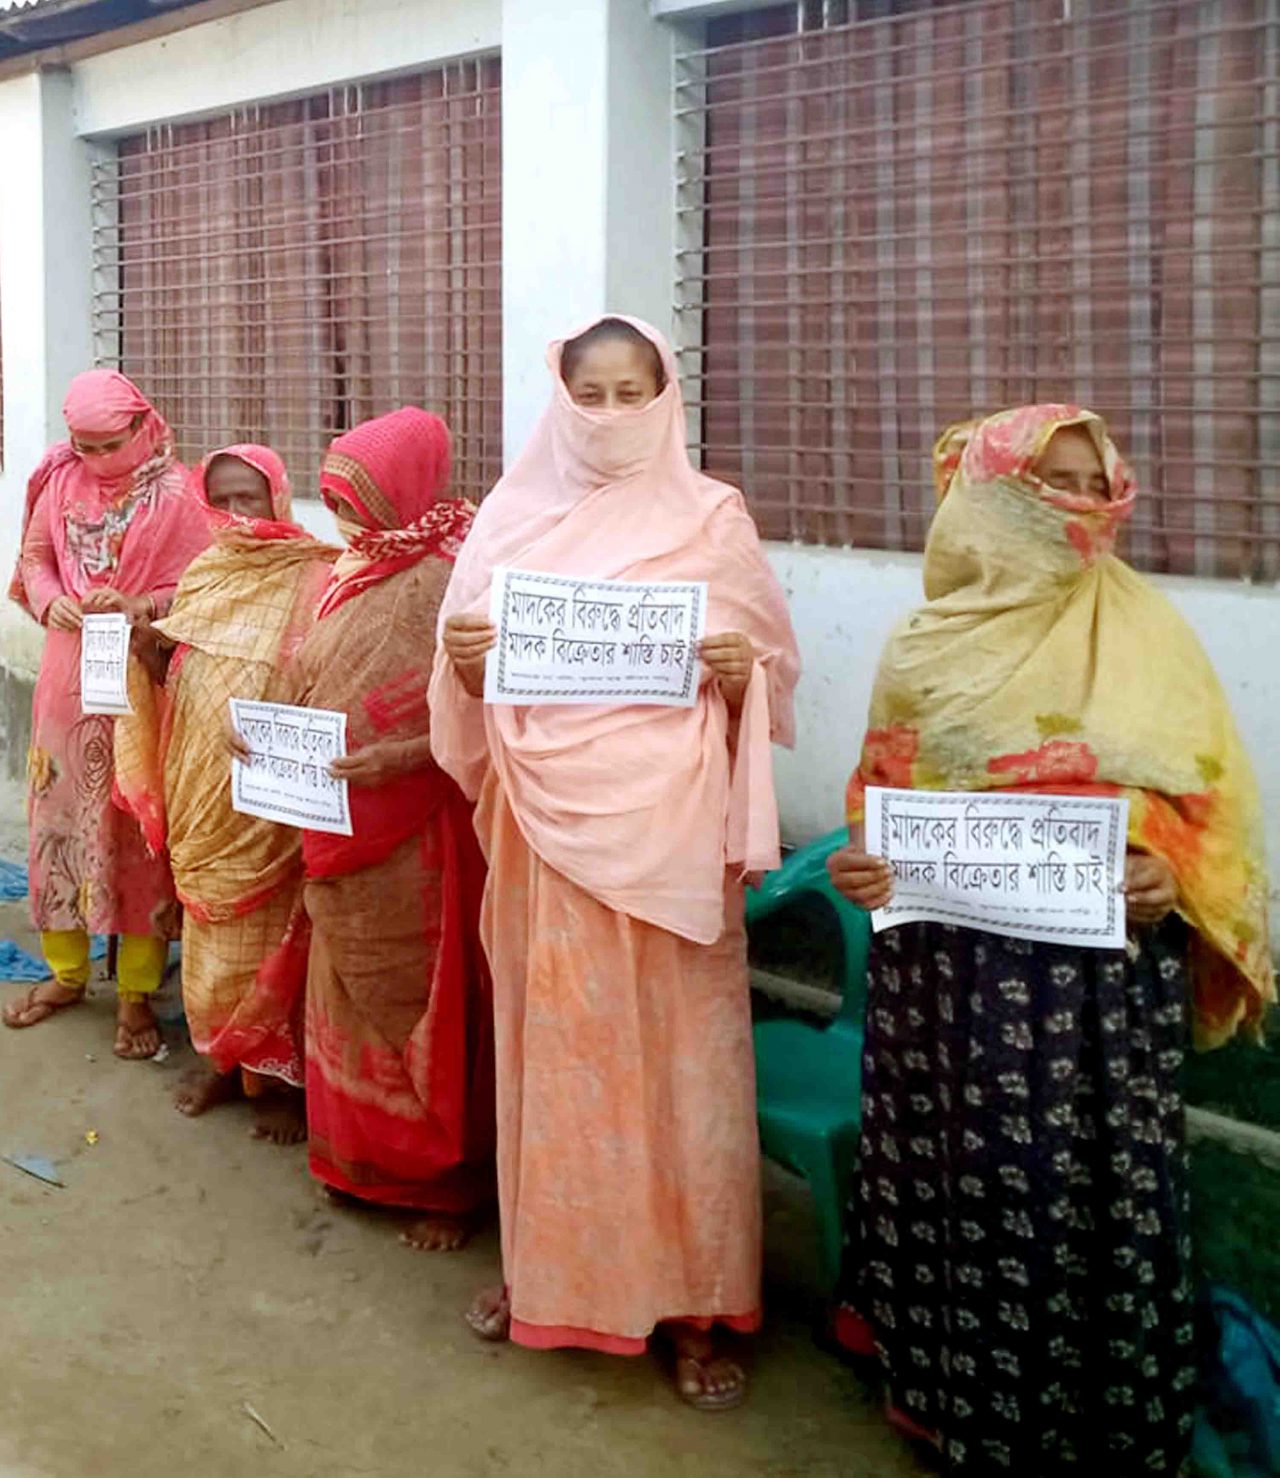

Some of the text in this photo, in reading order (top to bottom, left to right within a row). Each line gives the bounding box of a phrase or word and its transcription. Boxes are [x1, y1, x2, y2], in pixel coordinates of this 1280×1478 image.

[511, 583, 686, 634] মাদকের বিরুদ্ধে প্রতিবাদ
[508, 627, 688, 670] মাদক বিক্রেতার শাস্তি চাই
[889, 803, 1103, 851] মাদকের বিরুদ্ধে প্রতিবাদ
[891, 850, 1105, 895] মাদক বিক্রেতার শাস্তি চাই
